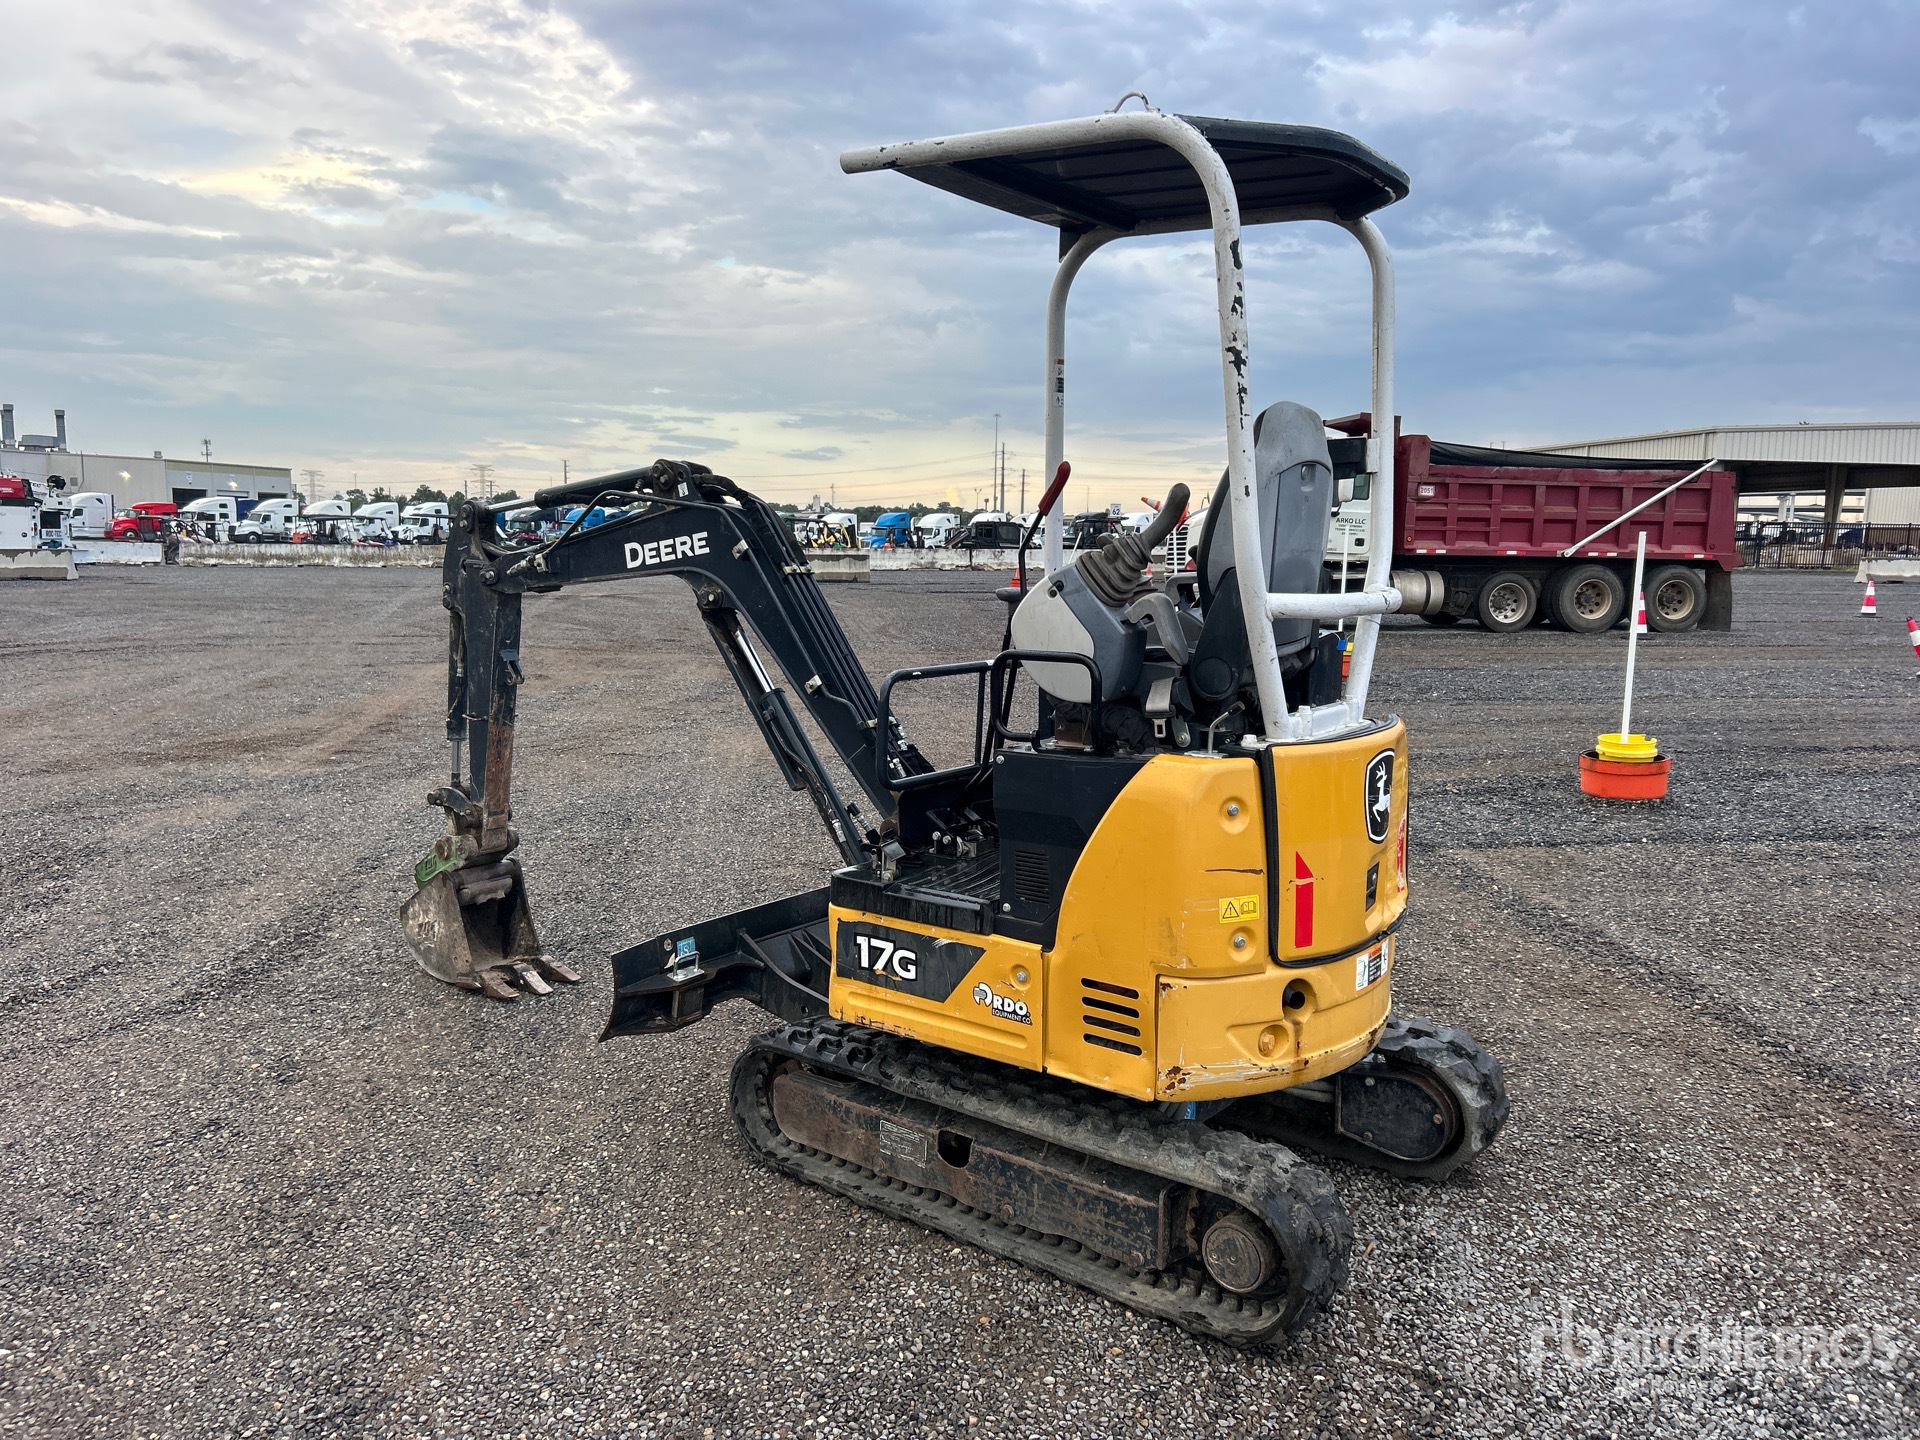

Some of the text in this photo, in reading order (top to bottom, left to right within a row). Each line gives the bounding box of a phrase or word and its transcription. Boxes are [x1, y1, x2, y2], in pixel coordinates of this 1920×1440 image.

[1112, 508, 1120, 516] 62
[624, 531, 710, 569] DEERE
[856, 935, 917, 980] 17G
[992, 1008, 1022, 1022] EQUIPMENT
